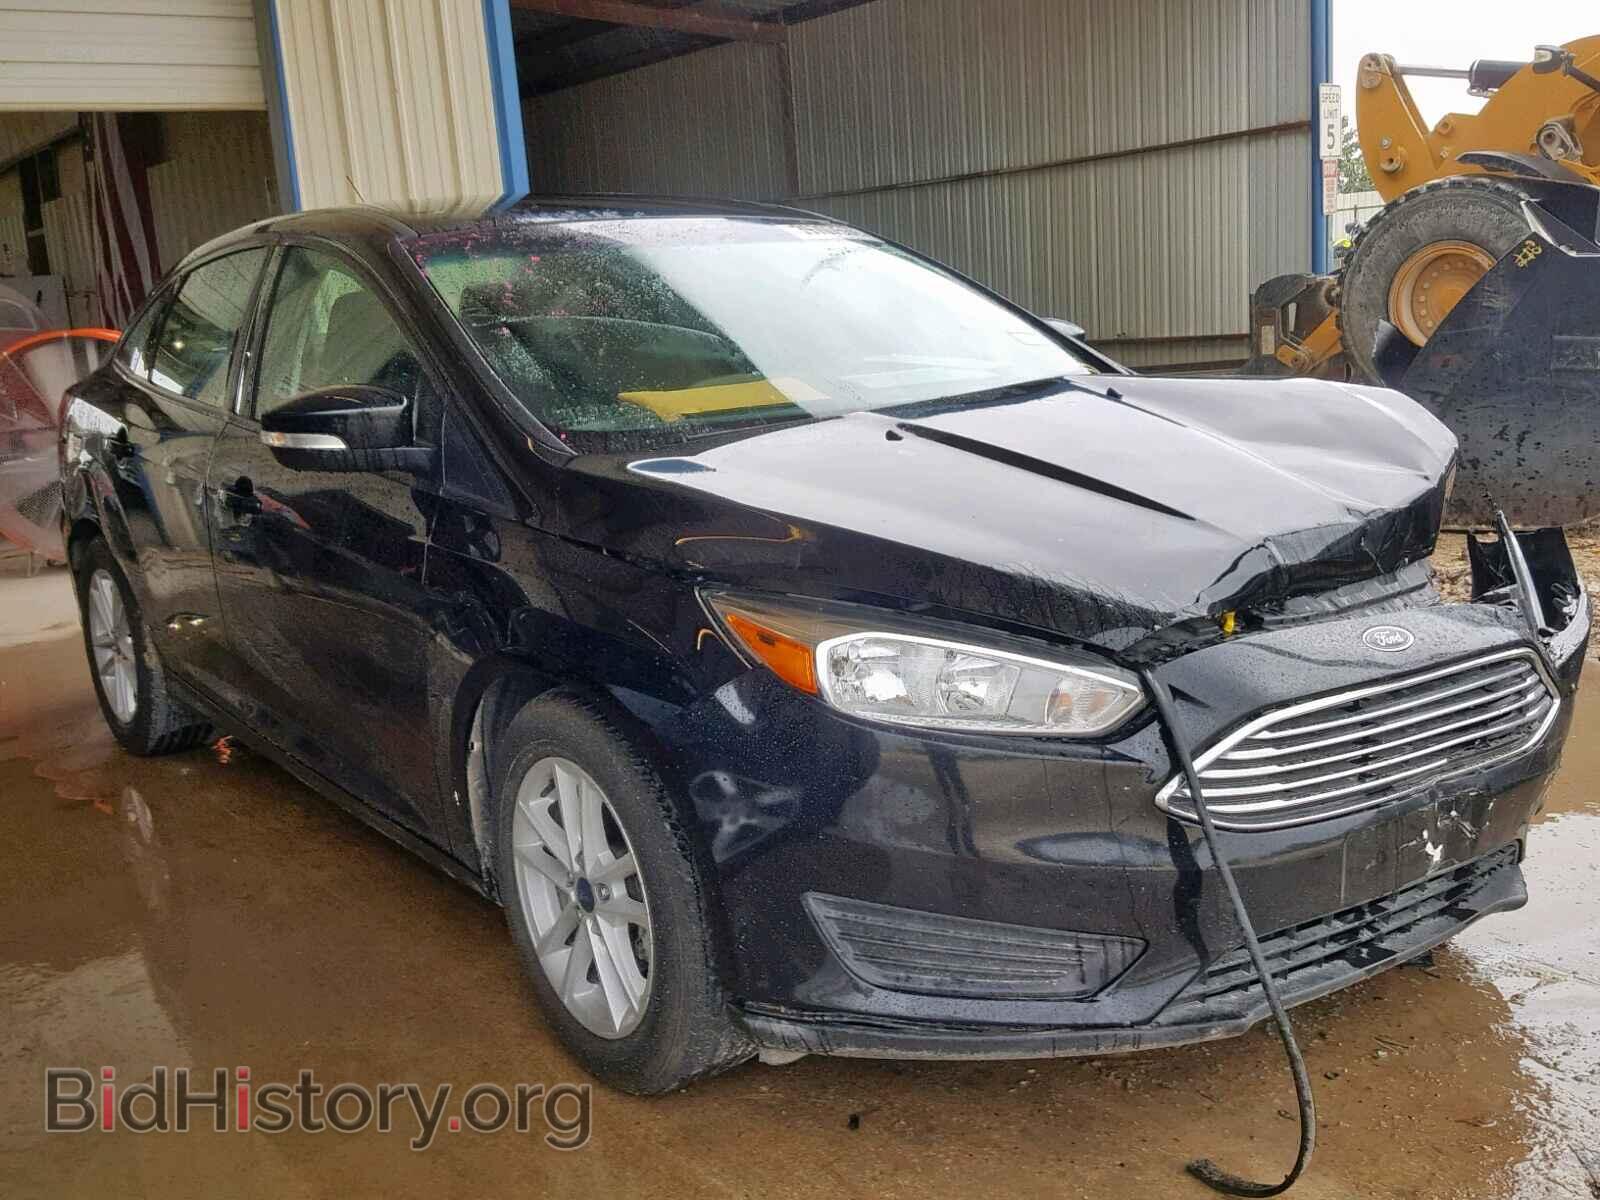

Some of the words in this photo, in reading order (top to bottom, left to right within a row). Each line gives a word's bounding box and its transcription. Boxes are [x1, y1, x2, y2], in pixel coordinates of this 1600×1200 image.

[1321, 92, 1339, 103] SPEED
[1327, 124, 1335, 150] 5
[1374, 630, 1404, 646] Ford
